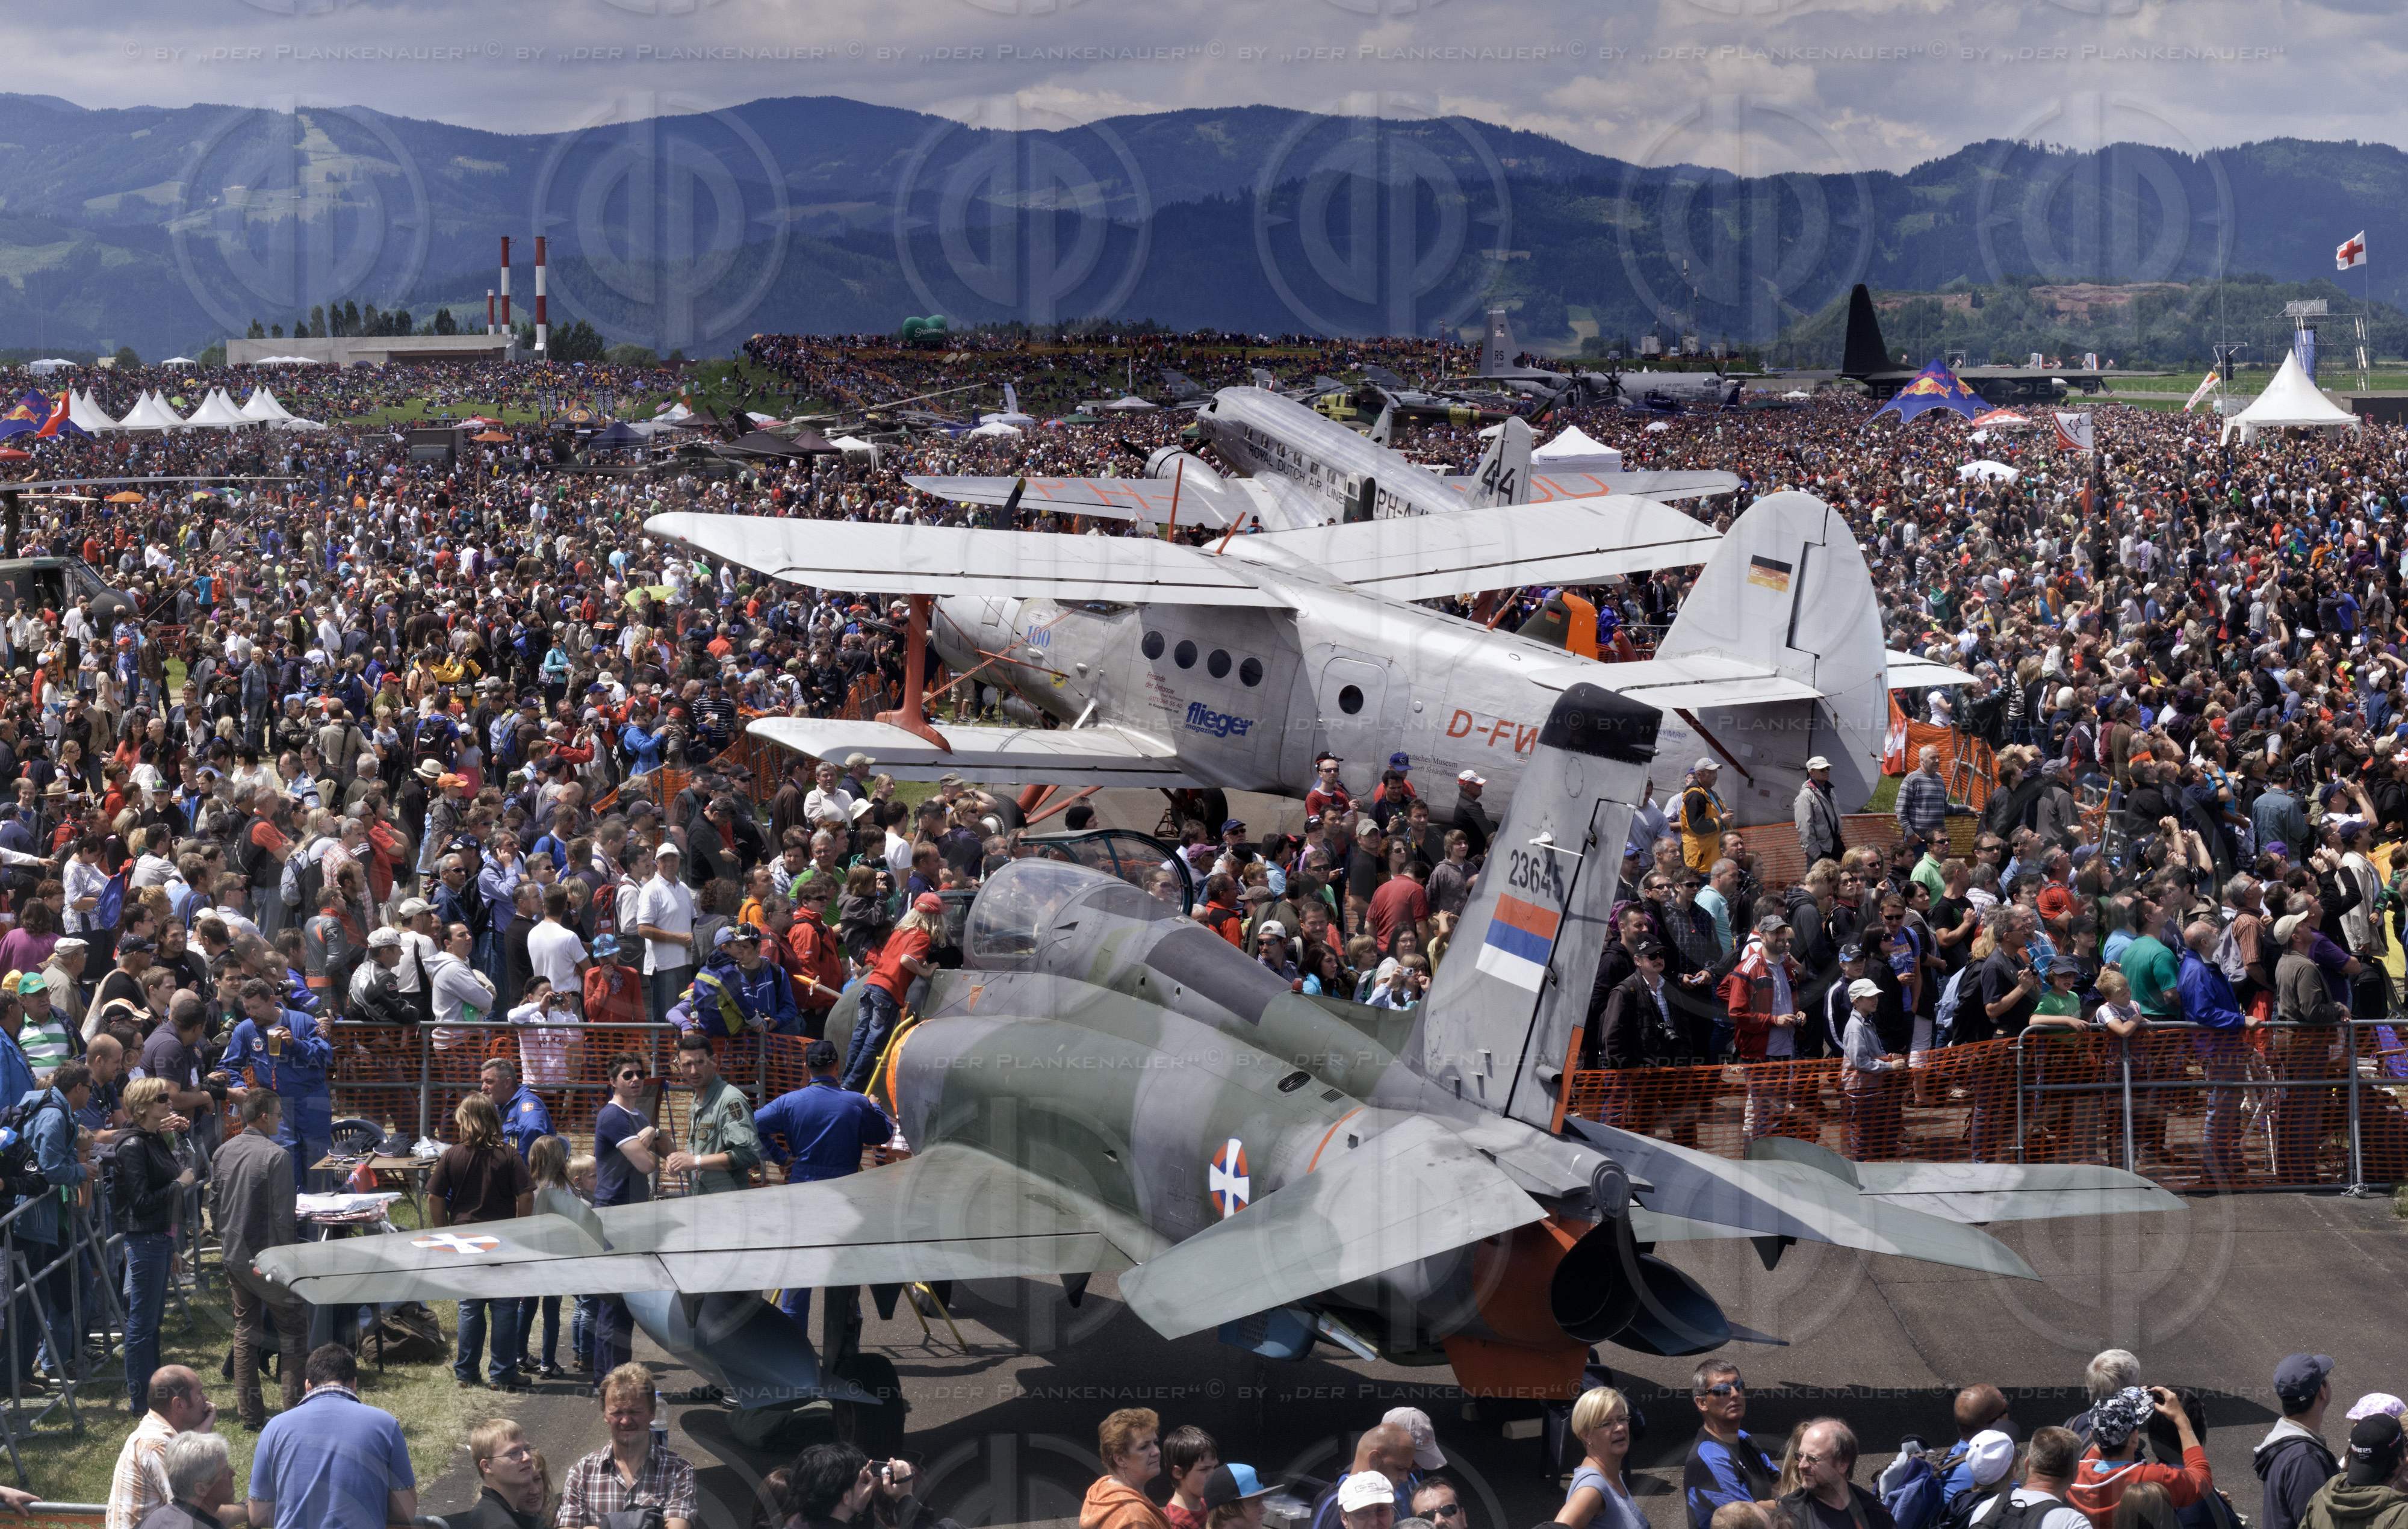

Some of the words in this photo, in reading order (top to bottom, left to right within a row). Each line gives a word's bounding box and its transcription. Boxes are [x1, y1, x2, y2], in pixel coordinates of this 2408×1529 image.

[1249, 444, 1273, 467] ROYAL
[1277, 459, 1305, 482] DUTCH
[1308, 477, 1322, 492] AIR
[1483, 459, 1516, 505] 44
[1027, 625, 1050, 648] 100
[1185, 723, 1214, 735] magazin
[1186, 701, 1254, 738] flieger
[1433, 757, 1458, 768] Museum
